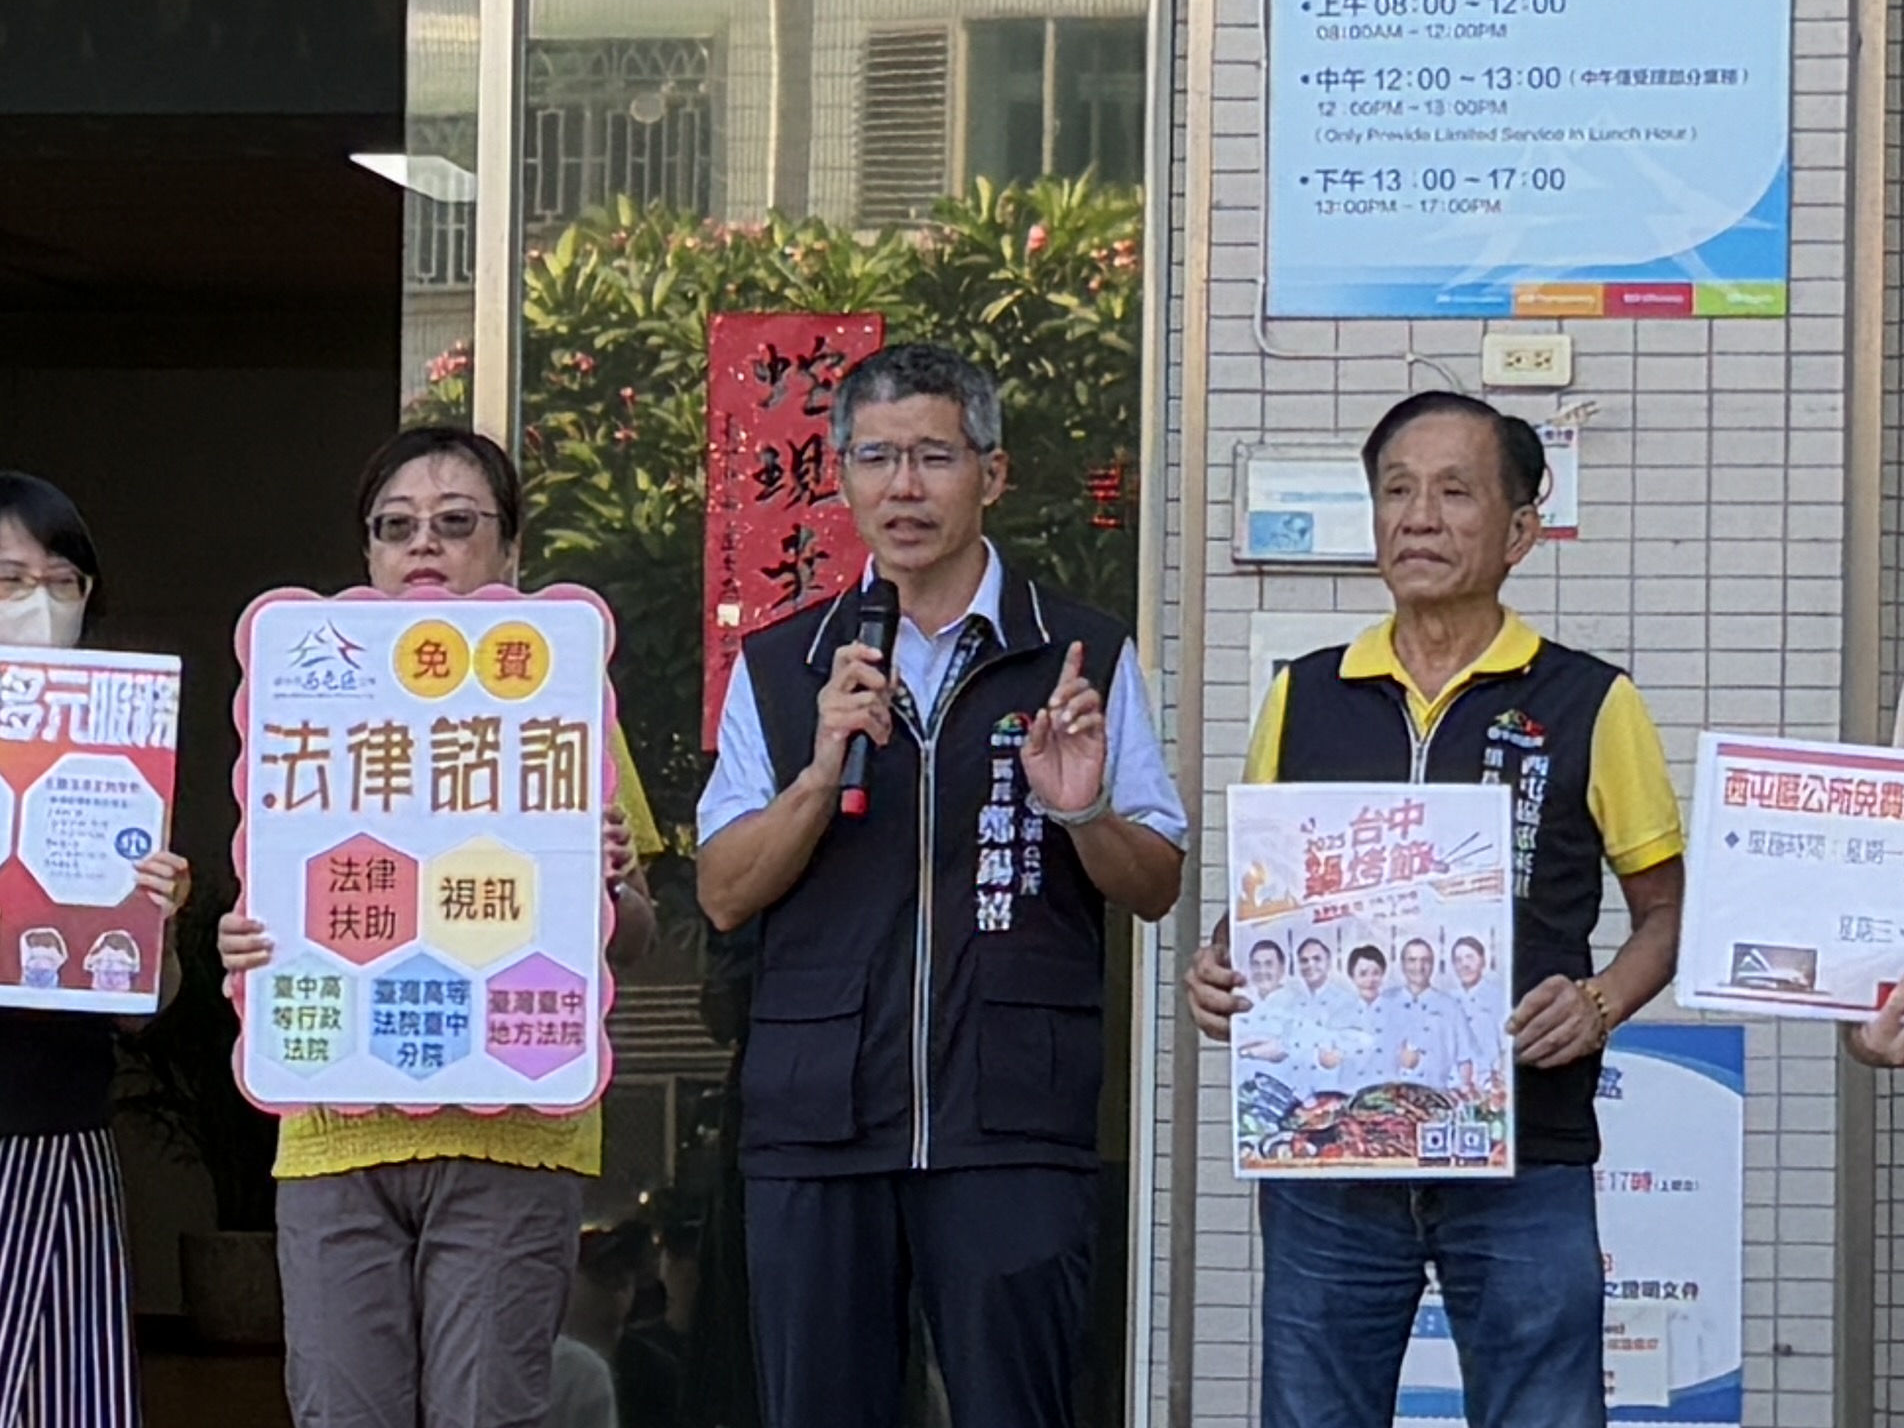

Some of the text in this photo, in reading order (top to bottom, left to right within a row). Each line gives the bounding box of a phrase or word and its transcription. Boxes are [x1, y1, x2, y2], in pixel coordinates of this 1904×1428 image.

[1315, 68, 1366, 93] 中午
[1375, 68, 1451, 91] 12:00
[1485, 67, 1560, 90] 13:00
[1316, 169, 1364, 193] 下午
[1374, 169, 1456, 192] 13:00
[1489, 169, 1566, 191] 17:00
[412, 638, 534, 682] 免費
[259, 715, 594, 815] 法律諮詢
[1349, 797, 1426, 848] 台中
[327, 856, 397, 894] 法律
[438, 877, 524, 923] 視訊
[327, 903, 397, 941] 扶助
[272, 975, 343, 1000] 臺中高
[373, 978, 472, 1006] 臺灣高等
[488, 989, 585, 1015] 臺灣臺中
[271, 1006, 343, 1032] 等行政
[371, 1011, 469, 1038] 法院臺中
[487, 1021, 585, 1047] 地方法院
[283, 1037, 330, 1062] 法院
[396, 1042, 445, 1068] 分院
